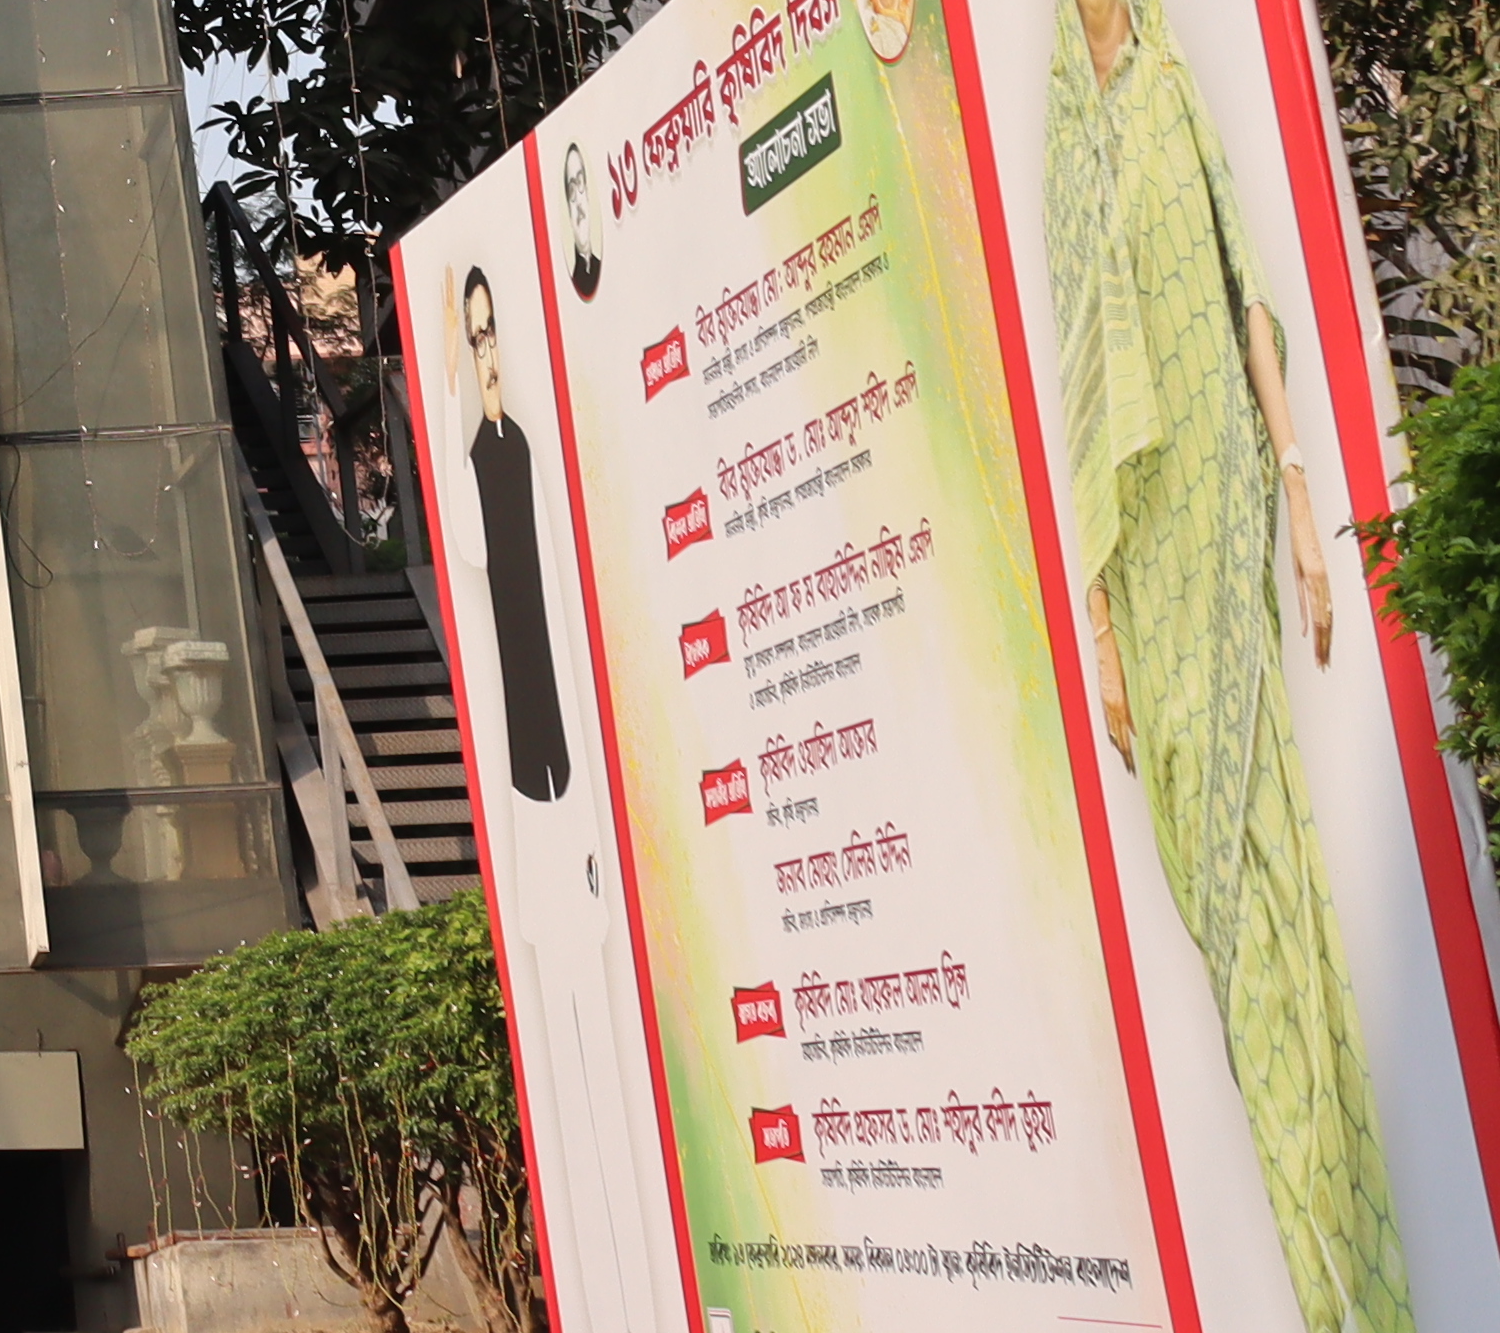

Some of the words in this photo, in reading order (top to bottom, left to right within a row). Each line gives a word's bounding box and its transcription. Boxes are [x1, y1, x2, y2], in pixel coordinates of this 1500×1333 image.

[608, 140, 638, 219] ১৩
[642, 59, 716, 175] ফেব্রুয়ারি
[715, 7, 786, 125] কৃষিবিদ
[743, 111, 807, 187] আলোচনা
[803, 88, 835, 145] সভা
[696, 306, 715, 347] বীর
[715, 280, 760, 343] মুক্তিযোদ্ধা
[816, 216, 853, 262] রহমান
[718, 458, 737, 496] বীর
[737, 438, 784, 499] মুক্তিযোদ্ধা
[859, 371, 889, 420] শহীদ
[736, 583, 775, 648] কৃষিবিদ
[788, 580, 802, 618] ফ
[802, 575, 815, 614] ম
[867, 525, 904, 577] নাছিম
[758, 733, 797, 798] কৃষিবিদ
[798, 721, 834, 772] ওয়াহিদা
[774, 858, 806, 894] জনাব
[841, 830, 878, 882] সেলিম
[874, 821, 910, 871] উদ্দিন
[792, 970, 833, 1031] কৃষিবিদ
[901, 967, 940, 1003] আলম
[812, 1096, 852, 1158] কৃষিবিদ
[981, 1086, 1017, 1140] রশীদ
